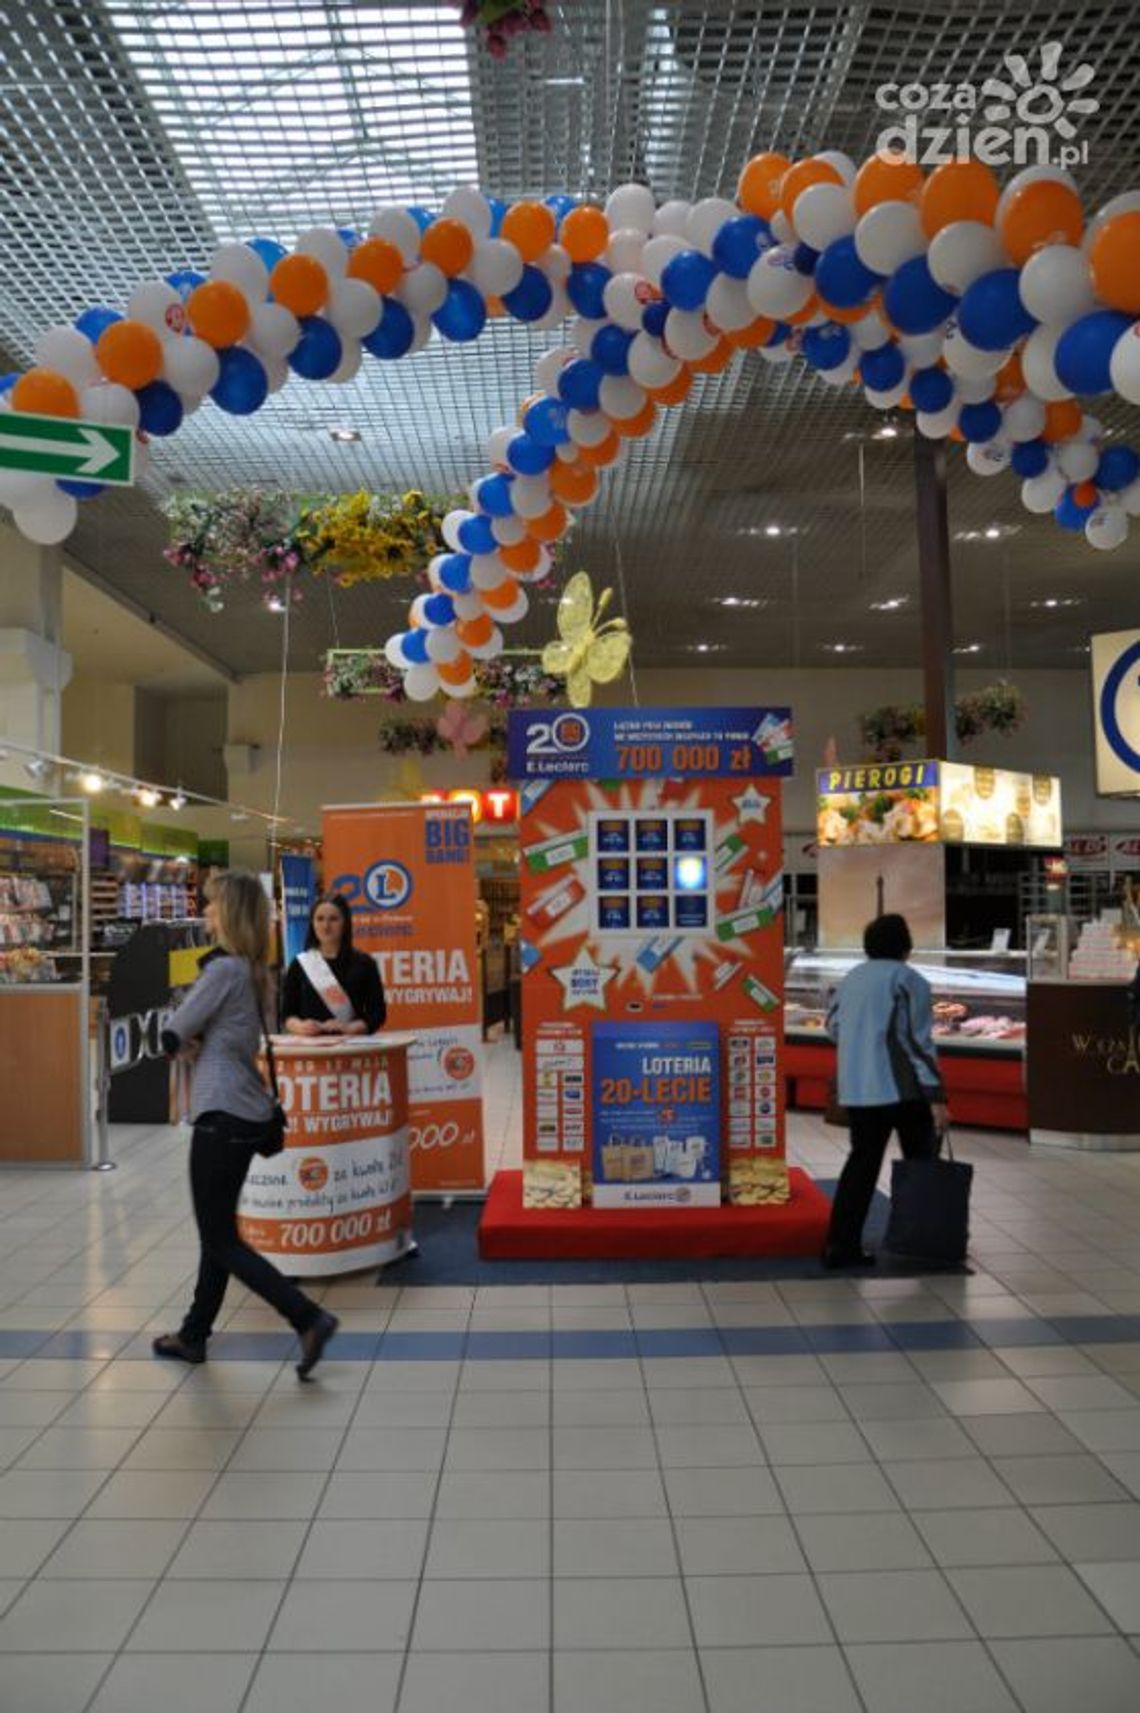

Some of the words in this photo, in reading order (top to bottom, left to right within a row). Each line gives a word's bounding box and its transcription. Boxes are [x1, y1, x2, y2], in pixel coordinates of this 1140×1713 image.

[617, 745, 662, 771] 700
[672, 745, 719, 770] 000
[829, 764, 923, 791] PIEROGI
[426, 819, 470, 848] BIG
[642, 1057, 711, 1075] LOTERIA
[276, 1072, 393, 1111] OTERIA
[601, 1077, 711, 1104] 20-LECIE
[280, 1222, 325, 1248] 700
[331, 1212, 372, 1243] 000
